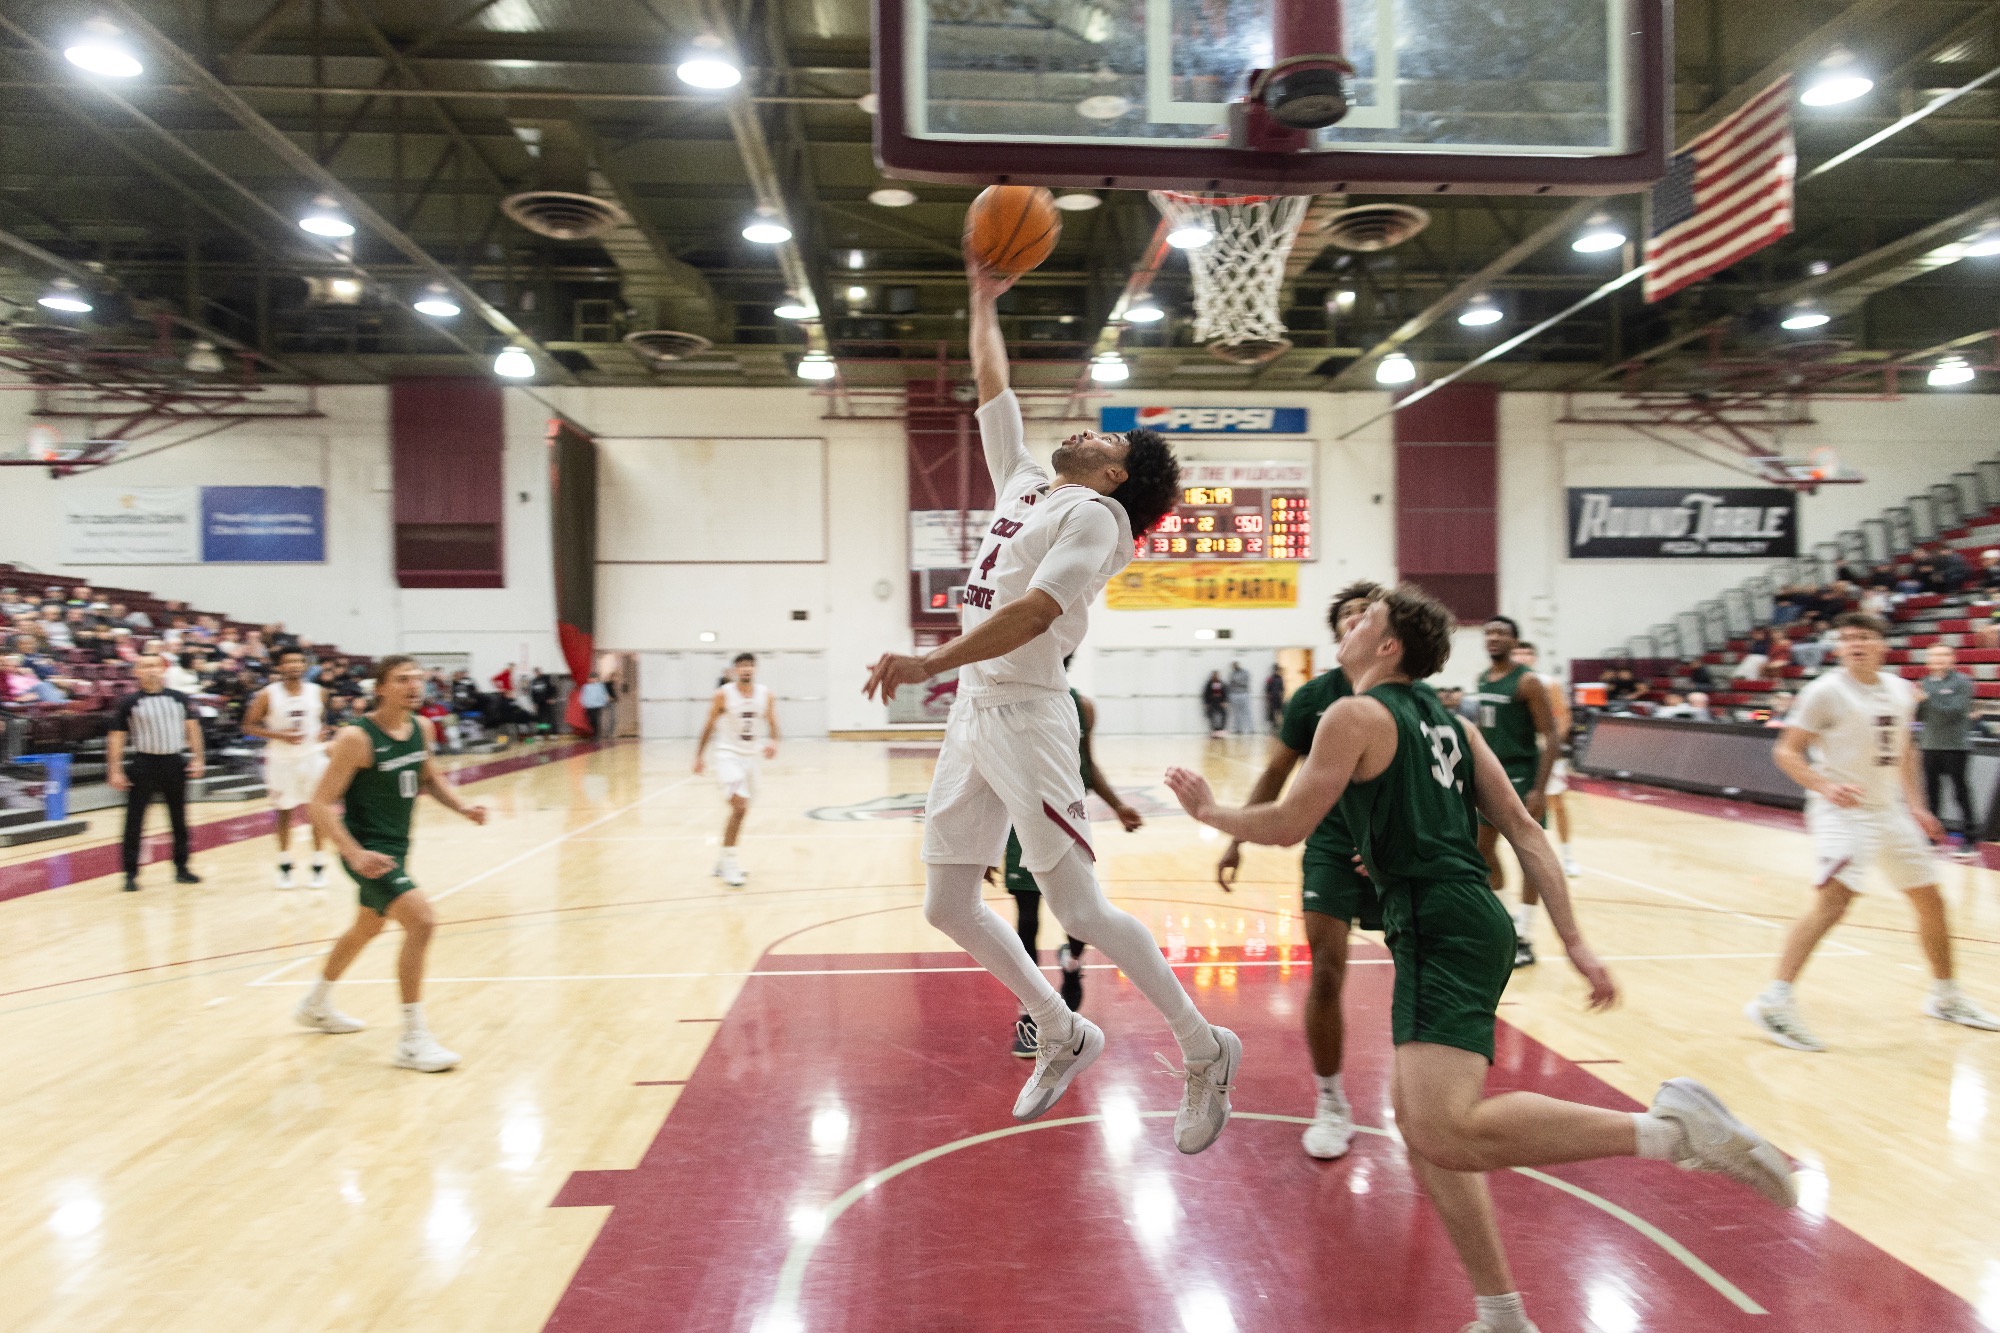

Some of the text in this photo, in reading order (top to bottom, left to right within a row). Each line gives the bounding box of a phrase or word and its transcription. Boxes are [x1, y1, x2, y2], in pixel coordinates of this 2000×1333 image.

[1166, 409, 1276, 430] PEPSI
[1574, 493, 1790, 545] ROUND TABLE
[980, 543, 1002, 581] 4
[963, 584, 996, 610] STATE
